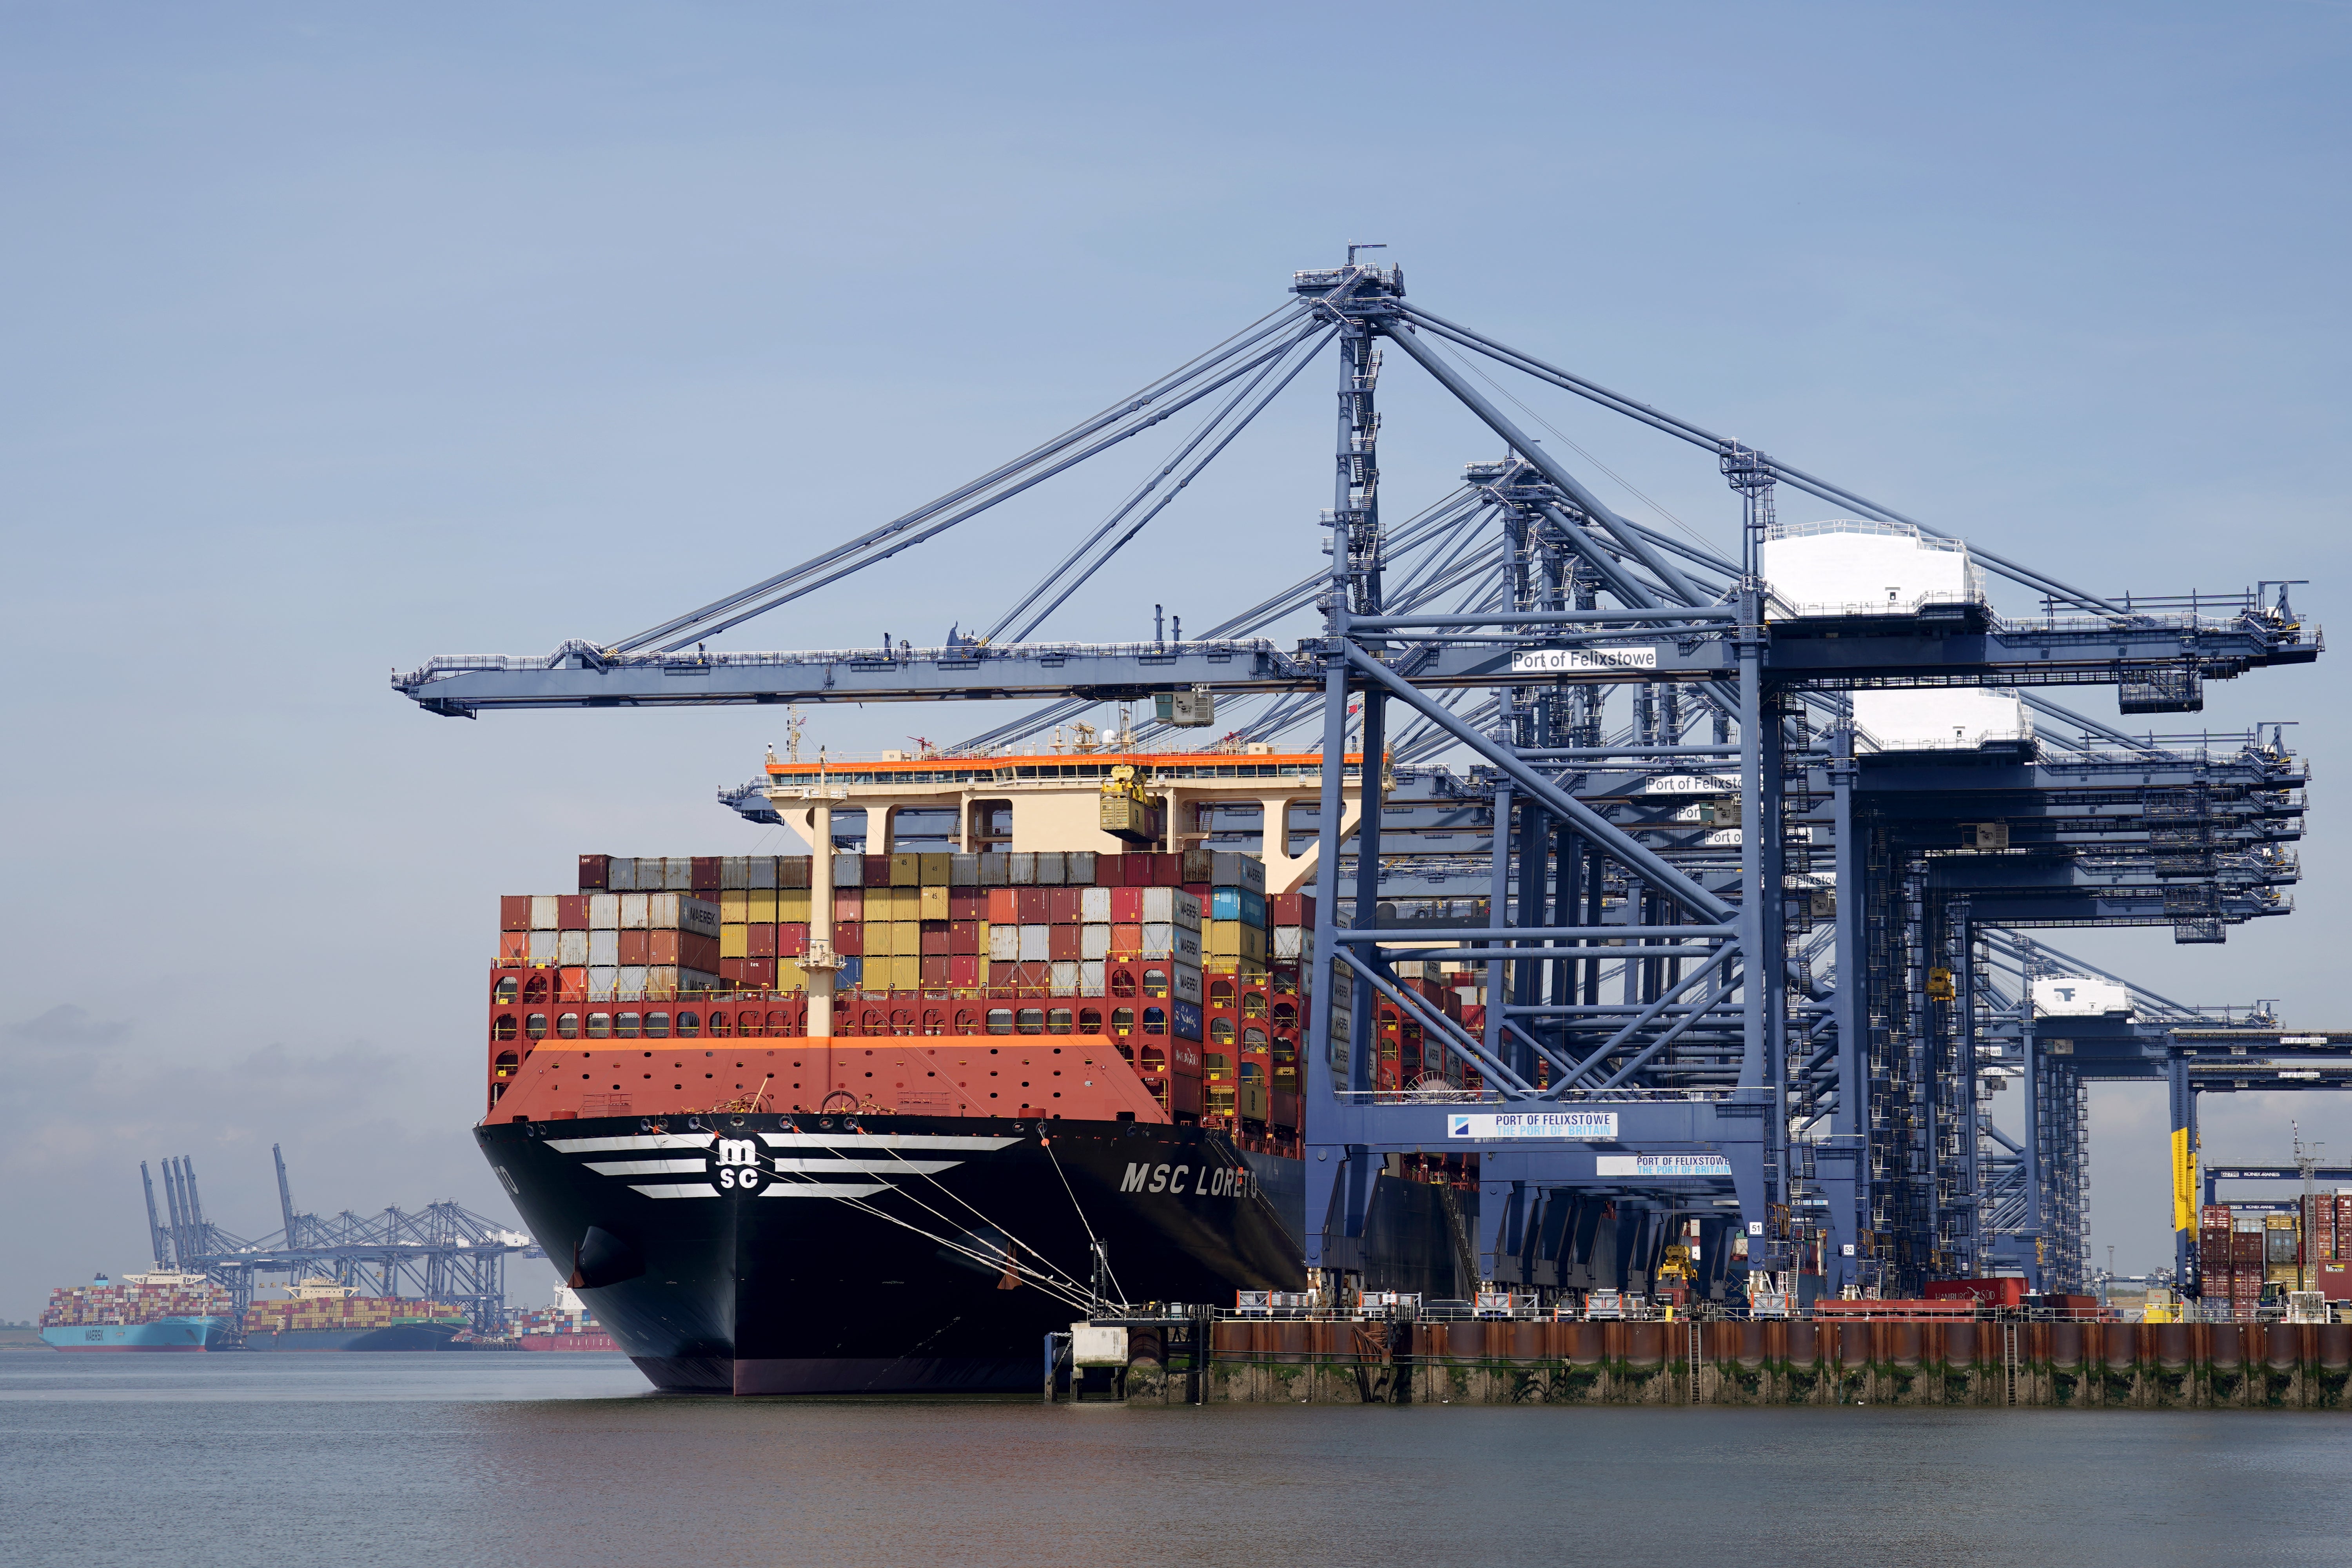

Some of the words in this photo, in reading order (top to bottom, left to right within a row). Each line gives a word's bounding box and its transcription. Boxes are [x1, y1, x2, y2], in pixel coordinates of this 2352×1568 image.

[1514, 653, 1546, 667] Port
[1550, 652, 1566, 667] of
[1571, 651, 1654, 666] Felixstowe
[1648, 778, 1673, 790] Port
[1678, 776, 1690, 789] of
[1679, 806, 1699, 818] Por
[1706, 831, 1730, 843] Port
[690, 907, 715, 926] MAERSK
[1180, 937, 1198, 956] MAERSK
[1180, 974, 1198, 992] MAERSK
[1496, 1116, 1523, 1125] PORT
[1529, 1115, 1540, 1125] OF
[1543, 1115, 1610, 1125] FELIXSTOWE
[1497, 1126, 1516, 1136] THE
[1520, 1126, 1547, 1135] PORT
[1554, 1125, 1563, 1135] OF
[1568, 1125, 1610, 1135] BRITAIN
[1637, 1157, 1659, 1165] PORT
[1637, 1166, 1653, 1174] THE
[1695, 1165, 1730, 1174] BRITAIN
[1120, 1162, 1189, 1193] MSC
[1196, 1166, 1257, 1199] LORETO
[1982, 1289, 1995, 1300] SÜD
[85, 1329, 104, 1341] MAERSK
